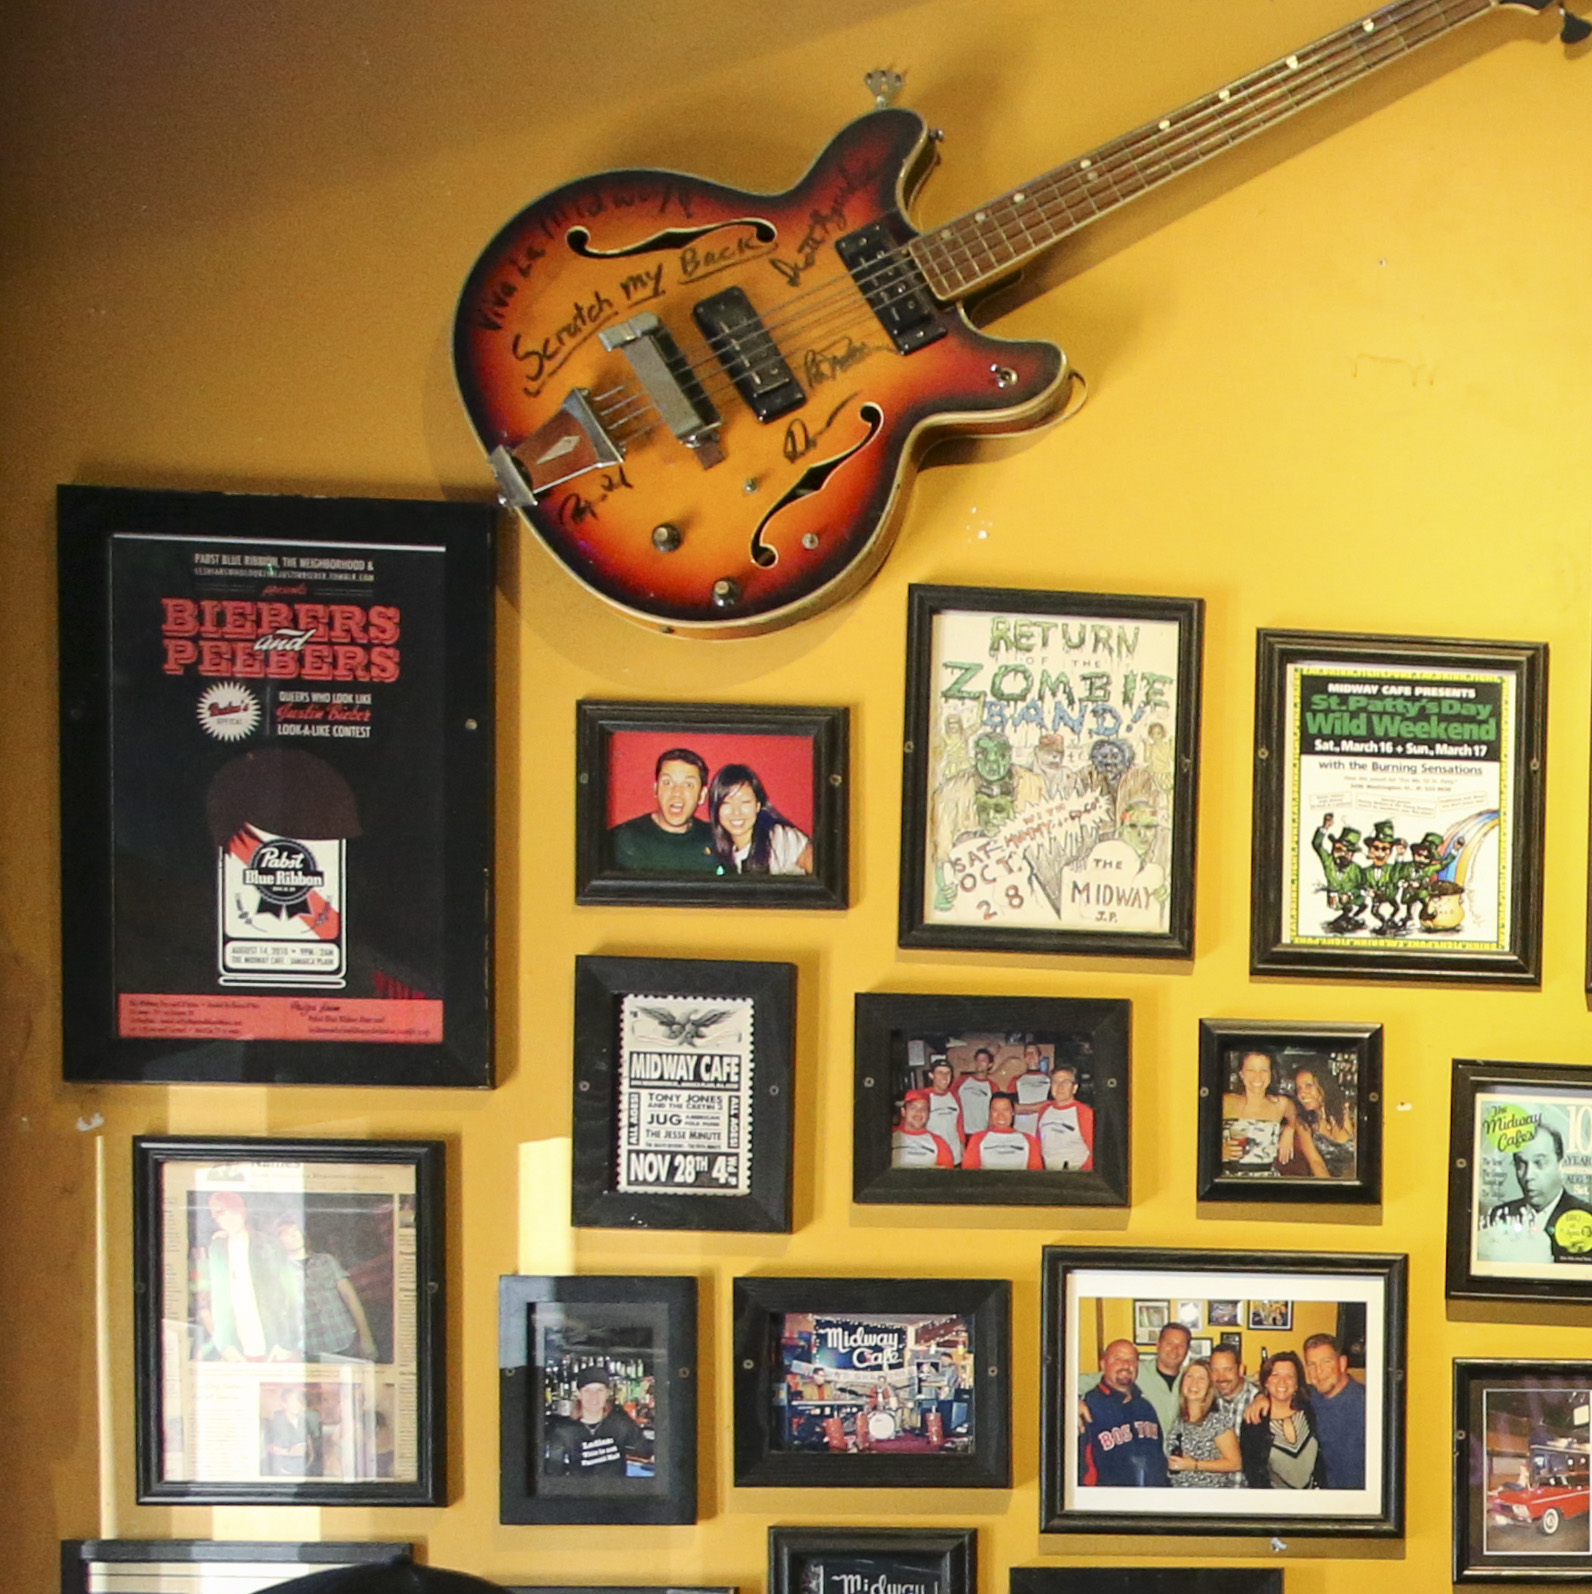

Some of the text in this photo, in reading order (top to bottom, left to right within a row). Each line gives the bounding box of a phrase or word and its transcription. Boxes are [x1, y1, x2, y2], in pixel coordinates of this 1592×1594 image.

[511, 237, 757, 383] Scratch my Back
[222, 554, 242, 565] BLUE
[282, 556, 297, 568] THE
[300, 557, 366, 571] NEIGHBORHOOD
[160, 597, 401, 645] BIEBERS
[253, 628, 316, 651] and
[989, 616, 1141, 657] RETURN
[162, 638, 401, 683] PEEBERS
[1026, 657, 1101, 668] OF THE
[940, 661, 1174, 709] ZOMBIE
[1327, 683, 1476, 699] MIDWAY CAFE PRESENTS
[278, 691, 372, 705] QUEERS WHO LOOK LIKE
[1311, 694, 1493, 720] St. Patty's Day
[982, 699, 1148, 736] BAND!
[1305, 712, 1497, 742] Wild Weekend
[333, 725, 371, 738] CONTEST
[1341, 739, 1378, 754] March
[1379, 741, 1393, 754] 16
[1435, 743, 1472, 757] March
[1472, 745, 1488, 758] 17
[1318, 760, 1483, 776] with the Burning Sensations
[260, 846, 305, 869] Pabst
[1092, 858, 1123, 870] THE
[244, 869, 324, 888] Blue Ribbon
[958, 853, 1024, 893] OCT.
[1070, 881, 1154, 910] MIDWAY
[1094, 910, 1119, 923] J.P.
[630, 1053, 739, 1082] MIDWAY CAFE
[648, 1092, 723, 1104] TONY JONES
[729, 1096, 740, 1115] ALL
[629, 1093, 640, 1145] ALL AGES!
[647, 1113, 683, 1126] JUG
[1484, 1113, 1543, 1135] Midway
[646, 1129, 721, 1141] THE JESSE MINUTE
[630, 1153, 729, 1184] NOV 28TH 4
[818, 1325, 904, 1354] Midway
[852, 1347, 903, 1373] Cafe
